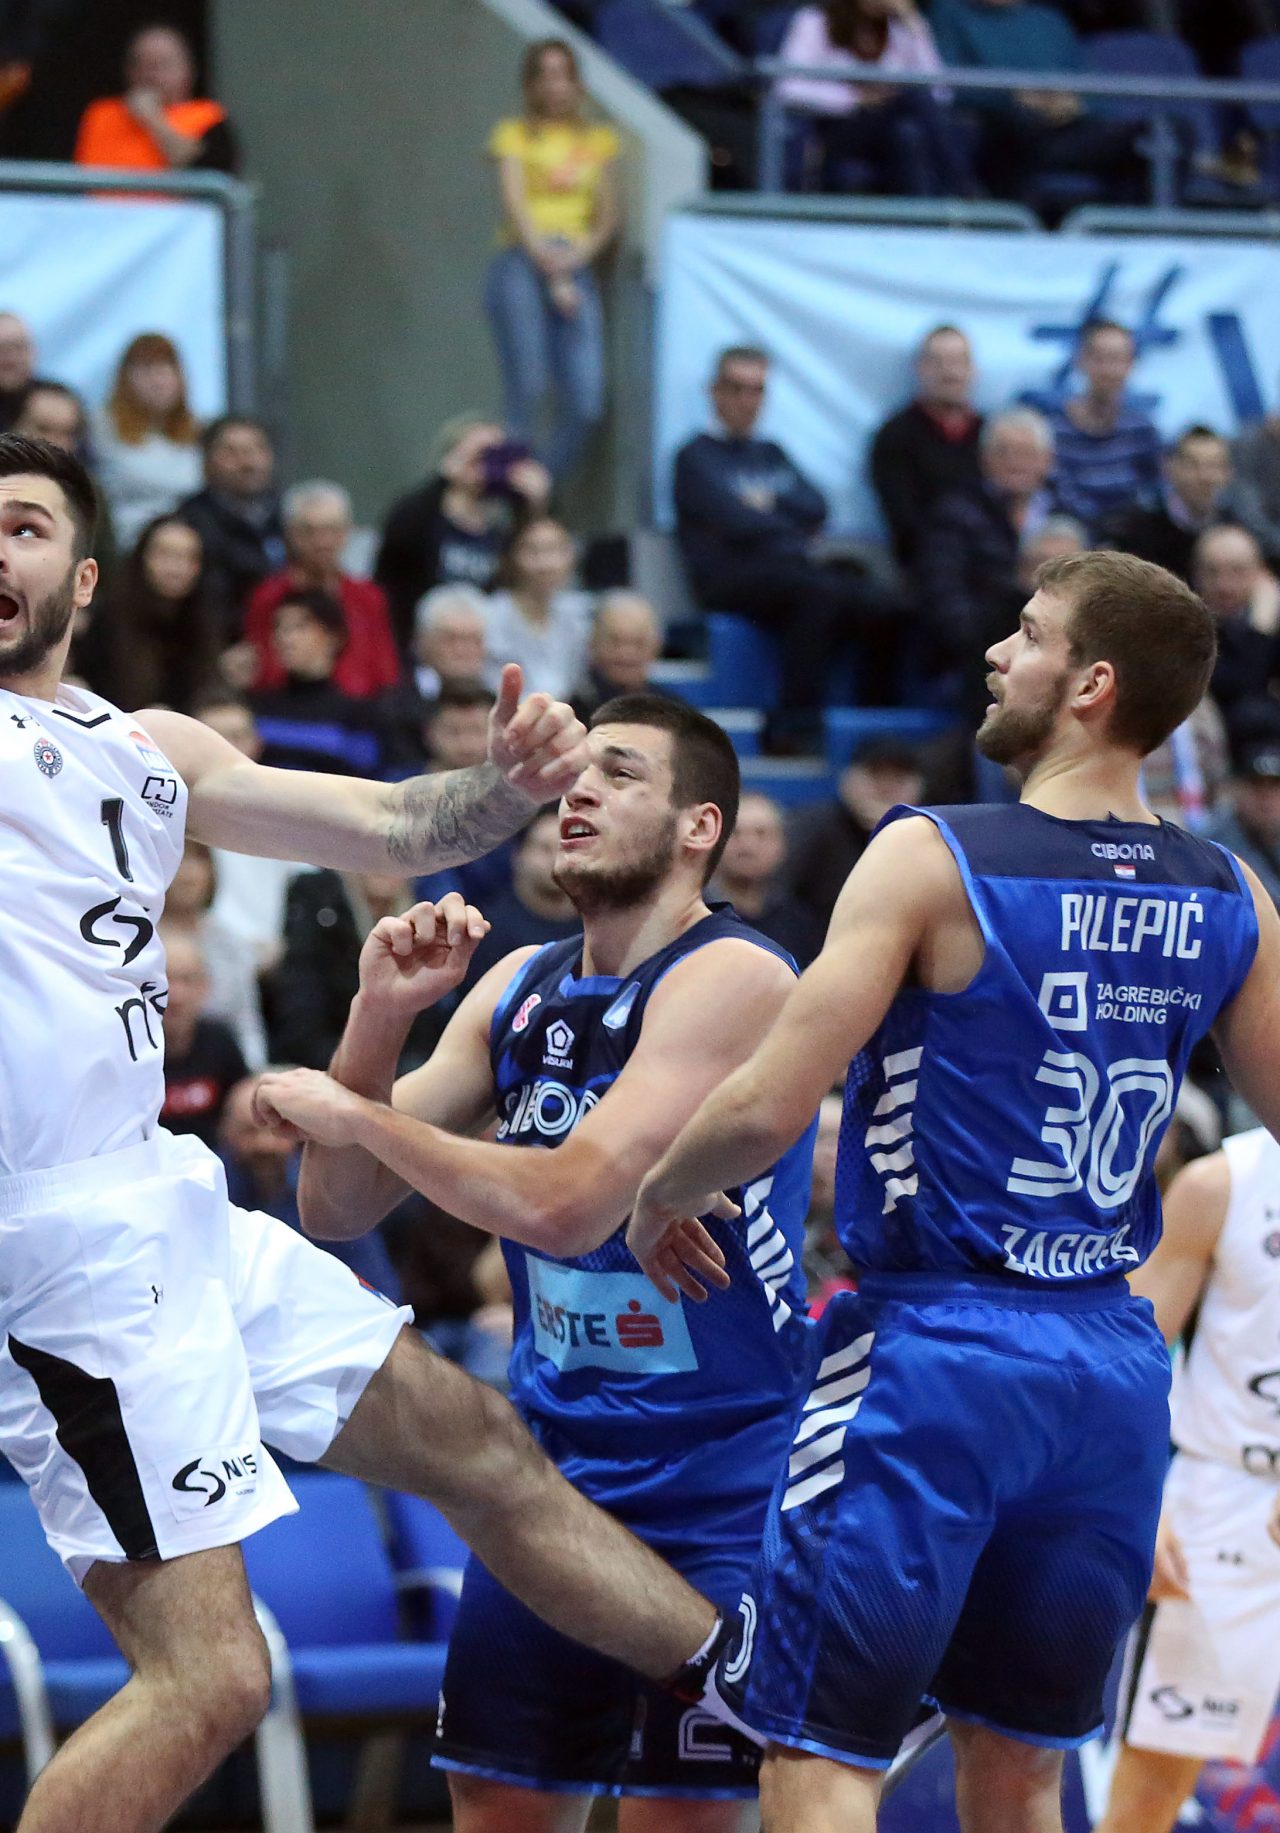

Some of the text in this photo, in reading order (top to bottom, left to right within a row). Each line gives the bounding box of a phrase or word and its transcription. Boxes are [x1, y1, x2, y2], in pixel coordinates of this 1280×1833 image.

[101, 797, 133, 882] 1
[1090, 842, 1155, 861] CIBONA
[1061, 892, 1204, 960] PILEPIĆ
[1095, 1003, 1167, 1024] HOLDING
[1097, 983, 1203, 1010] ZAGREBAČKI
[1006, 1049, 1174, 1209] 30
[536, 1295, 612, 1348] ERSTE
[221, 1453, 257, 1481] NIS
